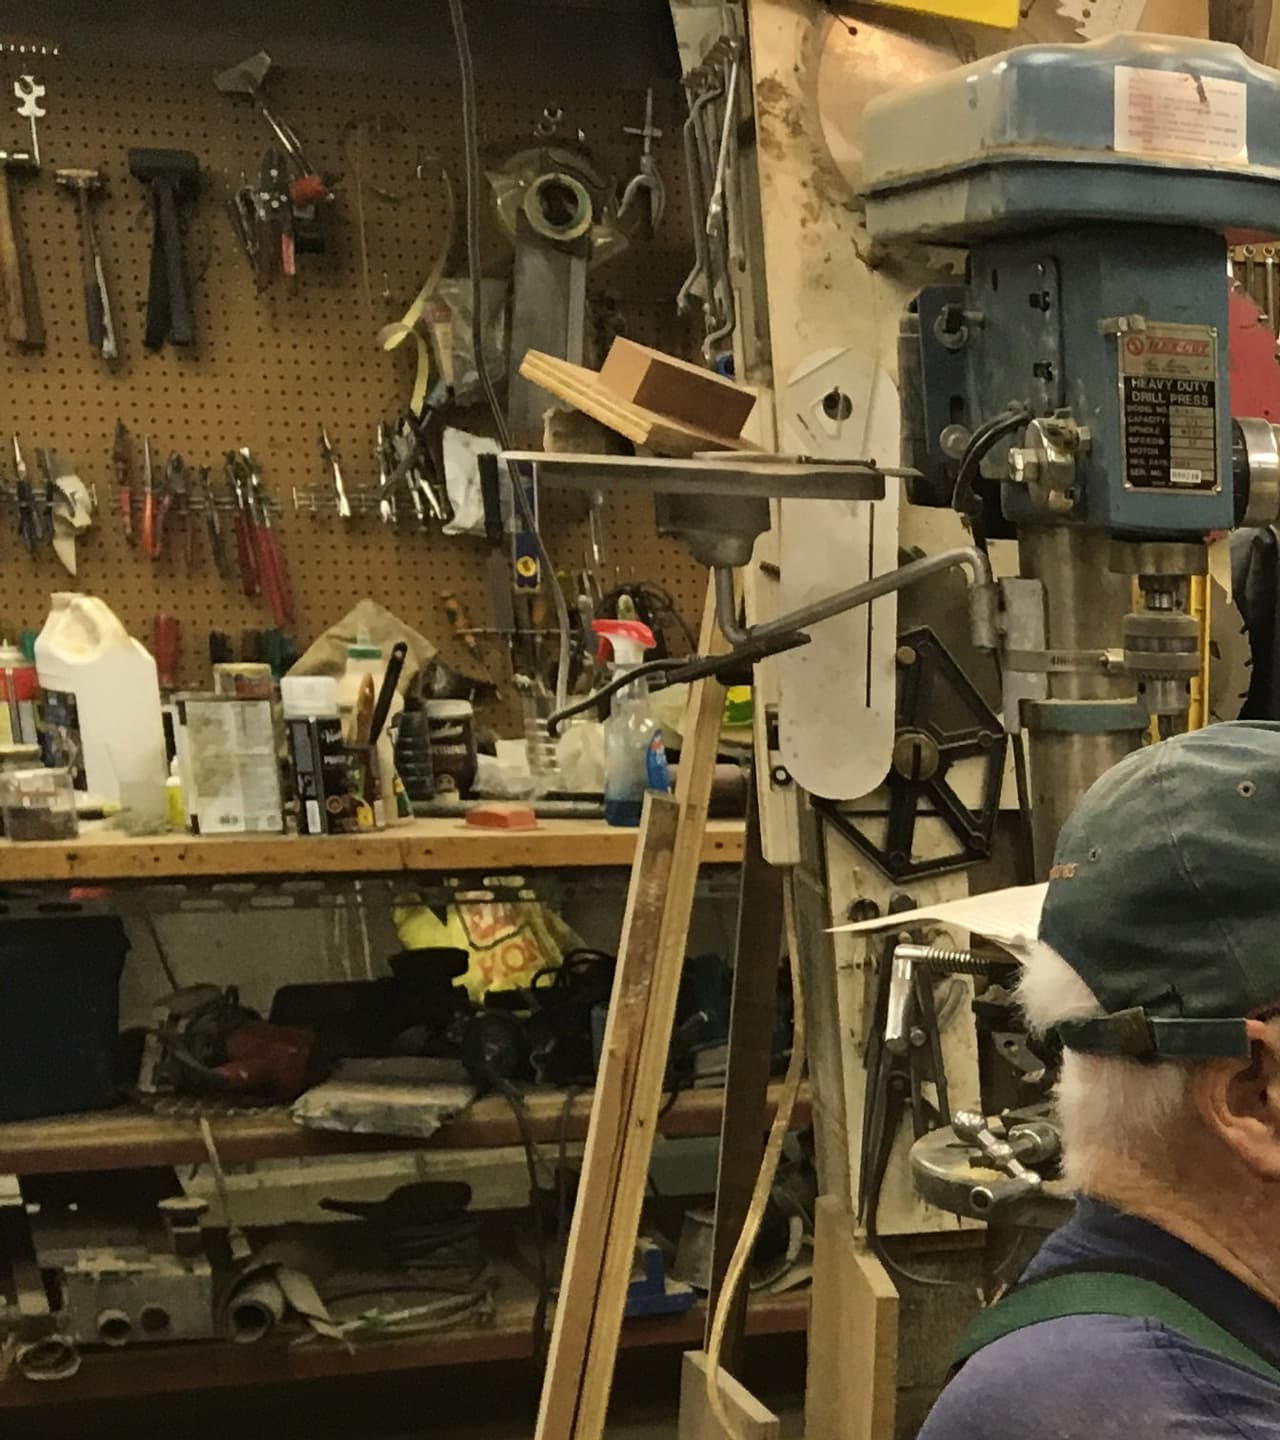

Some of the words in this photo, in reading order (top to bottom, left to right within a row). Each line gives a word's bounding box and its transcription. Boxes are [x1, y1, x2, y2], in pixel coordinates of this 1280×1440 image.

[1131, 378, 1173, 390] HEAVY
[1178, 381, 1208, 393] DUTY
[1131, 391, 1166, 404] DRILL
[1170, 393, 1209, 406] PRESS
